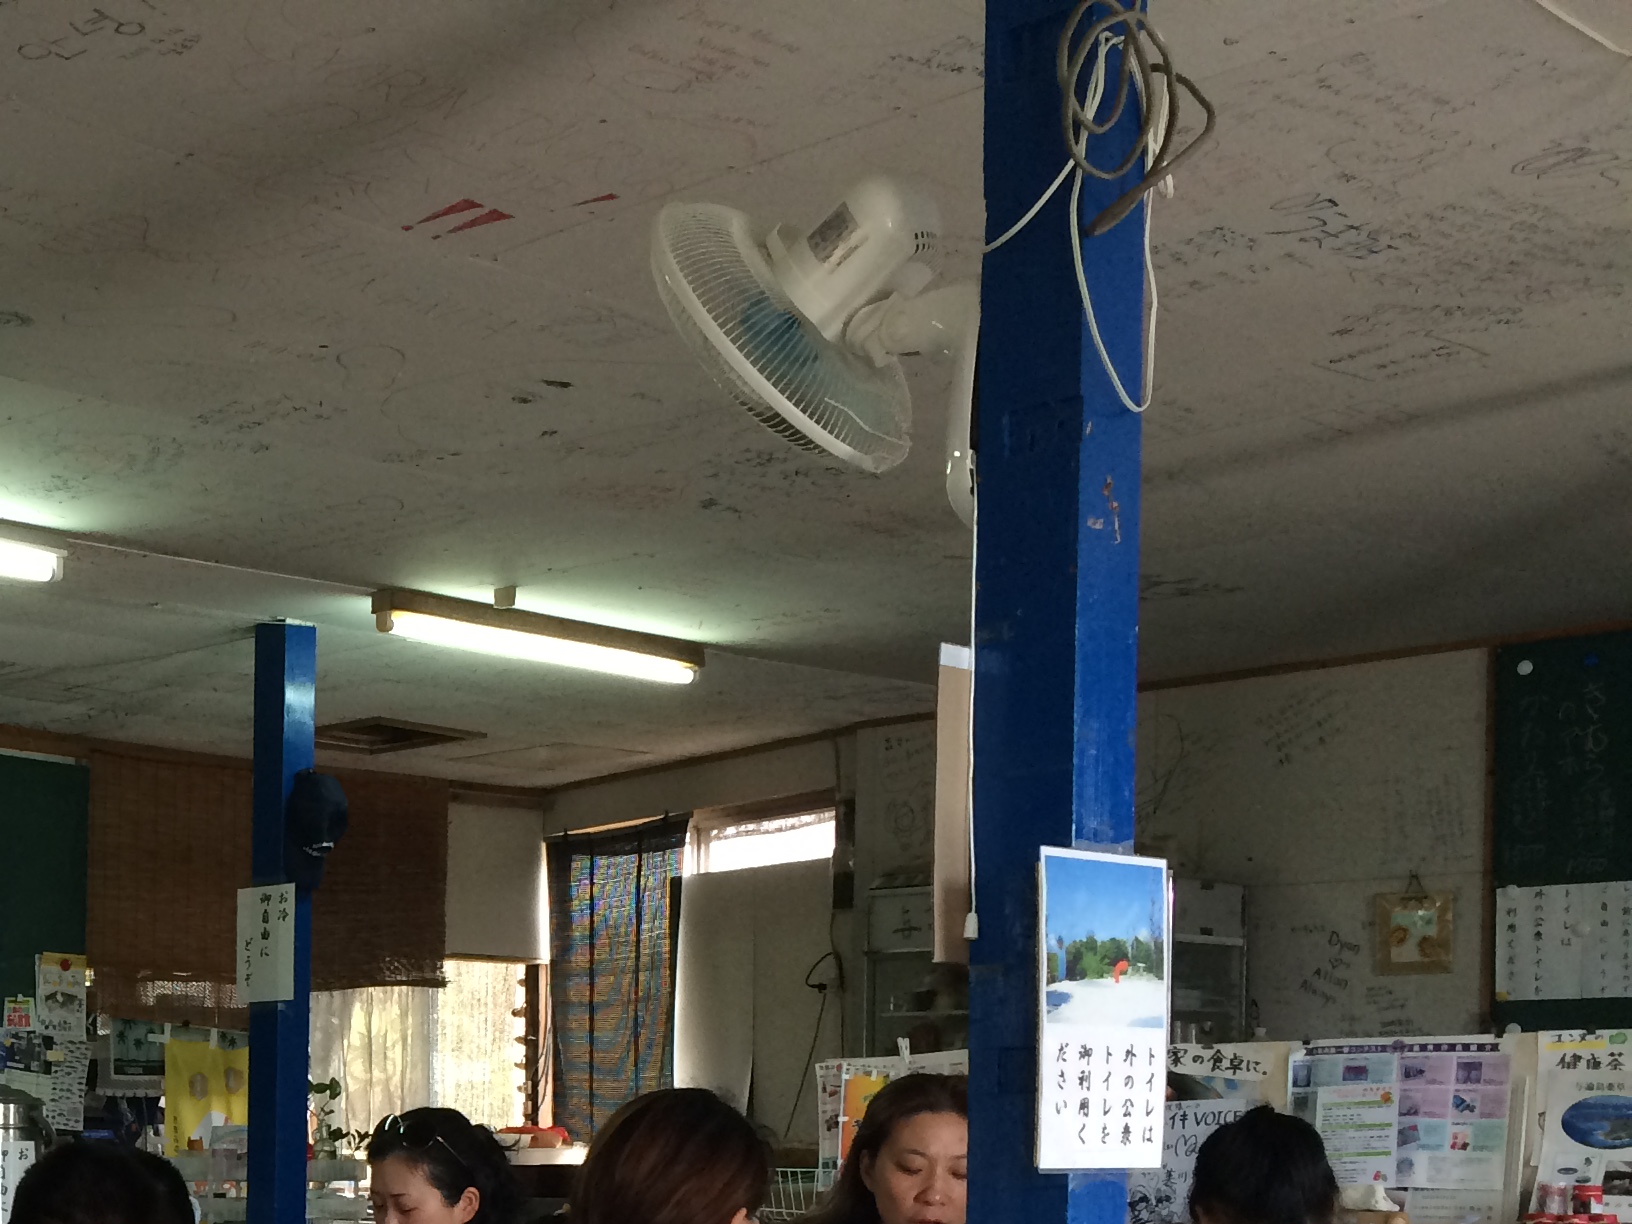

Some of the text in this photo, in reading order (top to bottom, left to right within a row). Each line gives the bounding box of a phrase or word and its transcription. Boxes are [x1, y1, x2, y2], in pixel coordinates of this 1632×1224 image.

[259, 892, 272, 958] 御自由に
[276, 890, 289, 922] お冷
[244, 937, 254, 987] どうぞ
[1054, 1042, 1068, 1116] ださい
[1077, 1043, 1093, 1146] 御利用く
[1100, 1046, 1113, 1145] トイレを
[1120, 1043, 1137, 1146] 外の公衆
[1141, 1047, 1156, 1145] トイレは
[1555, 1051, 1627, 1071] 健康茶
